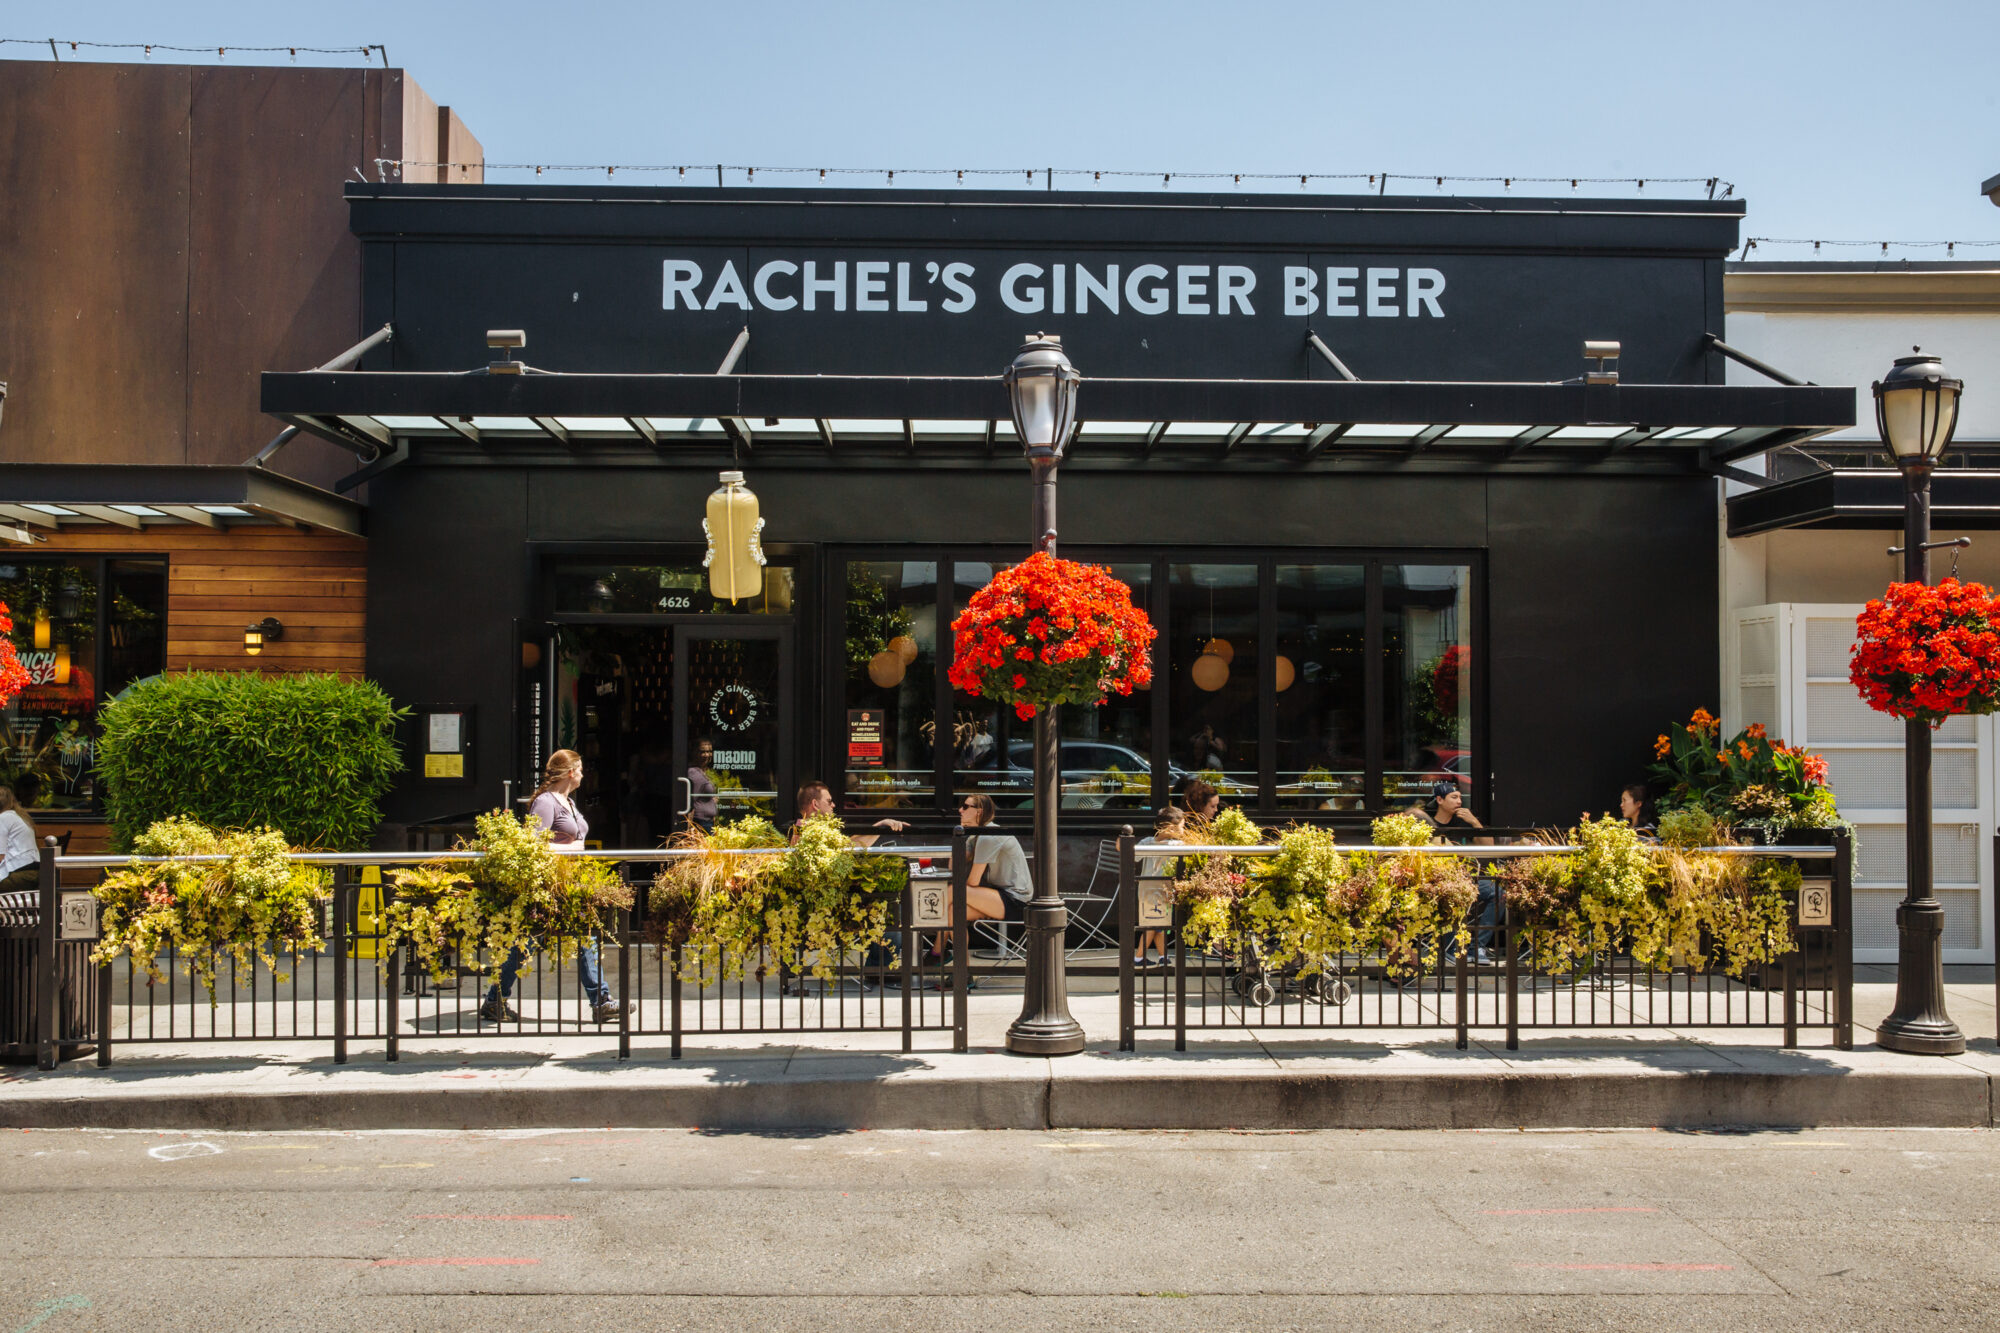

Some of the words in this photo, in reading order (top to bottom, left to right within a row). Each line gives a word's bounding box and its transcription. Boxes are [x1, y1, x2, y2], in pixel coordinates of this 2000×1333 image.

[662, 259, 977, 314] RACHEL'S
[1000, 262, 1257, 316] GINGER
[1284, 265, 1446, 318] BEER
[658, 596, 690, 608] 4626
[725, 684, 758, 707] GINGER
[709, 689, 729, 731] RACHEL'S
[737, 710, 757, 731] BEER
[859, 778, 890, 786] handmade
[891, 778, 906, 786] fresh
[907, 778, 921, 786] soda
[1001, 779, 1019, 787] mules
